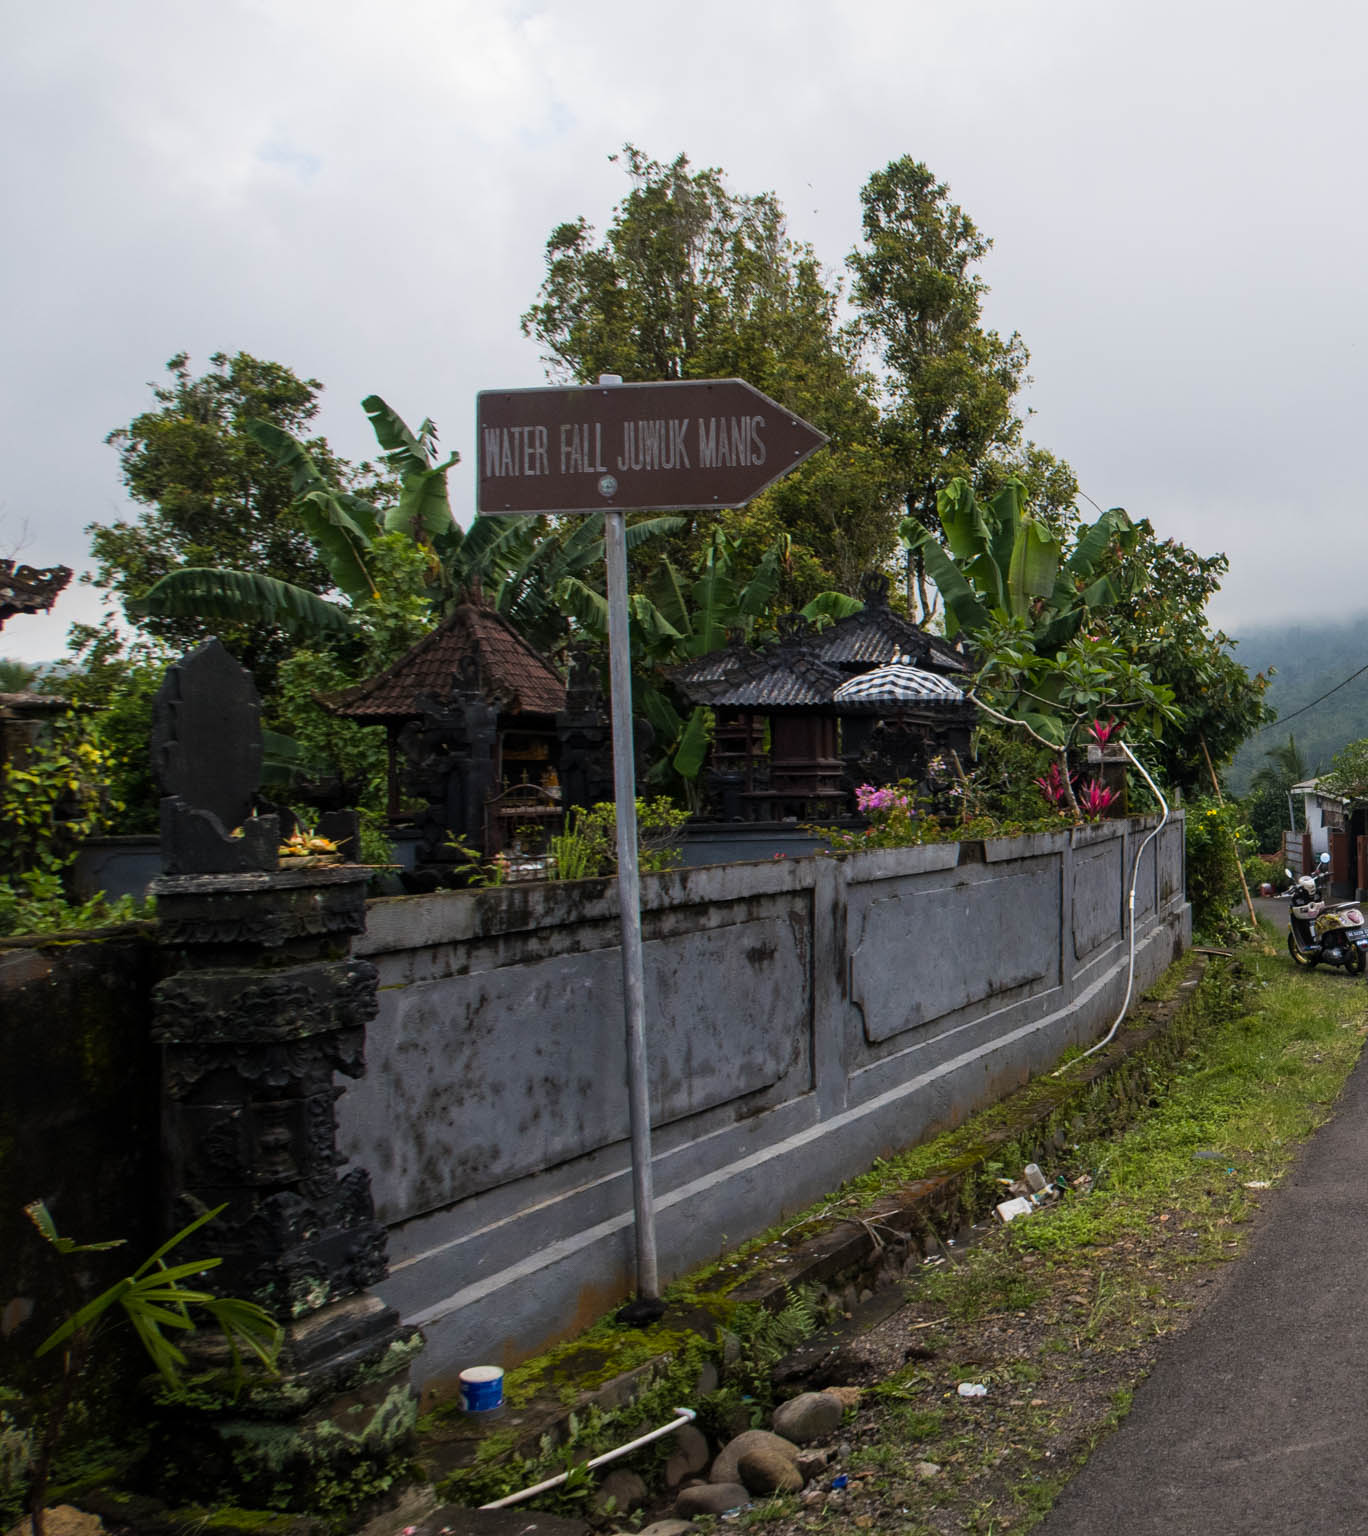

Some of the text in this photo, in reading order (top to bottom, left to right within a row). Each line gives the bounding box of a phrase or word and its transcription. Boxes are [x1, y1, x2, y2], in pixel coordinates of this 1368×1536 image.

[484, 415, 768, 477] WATER FALL JUWUK MANIS
